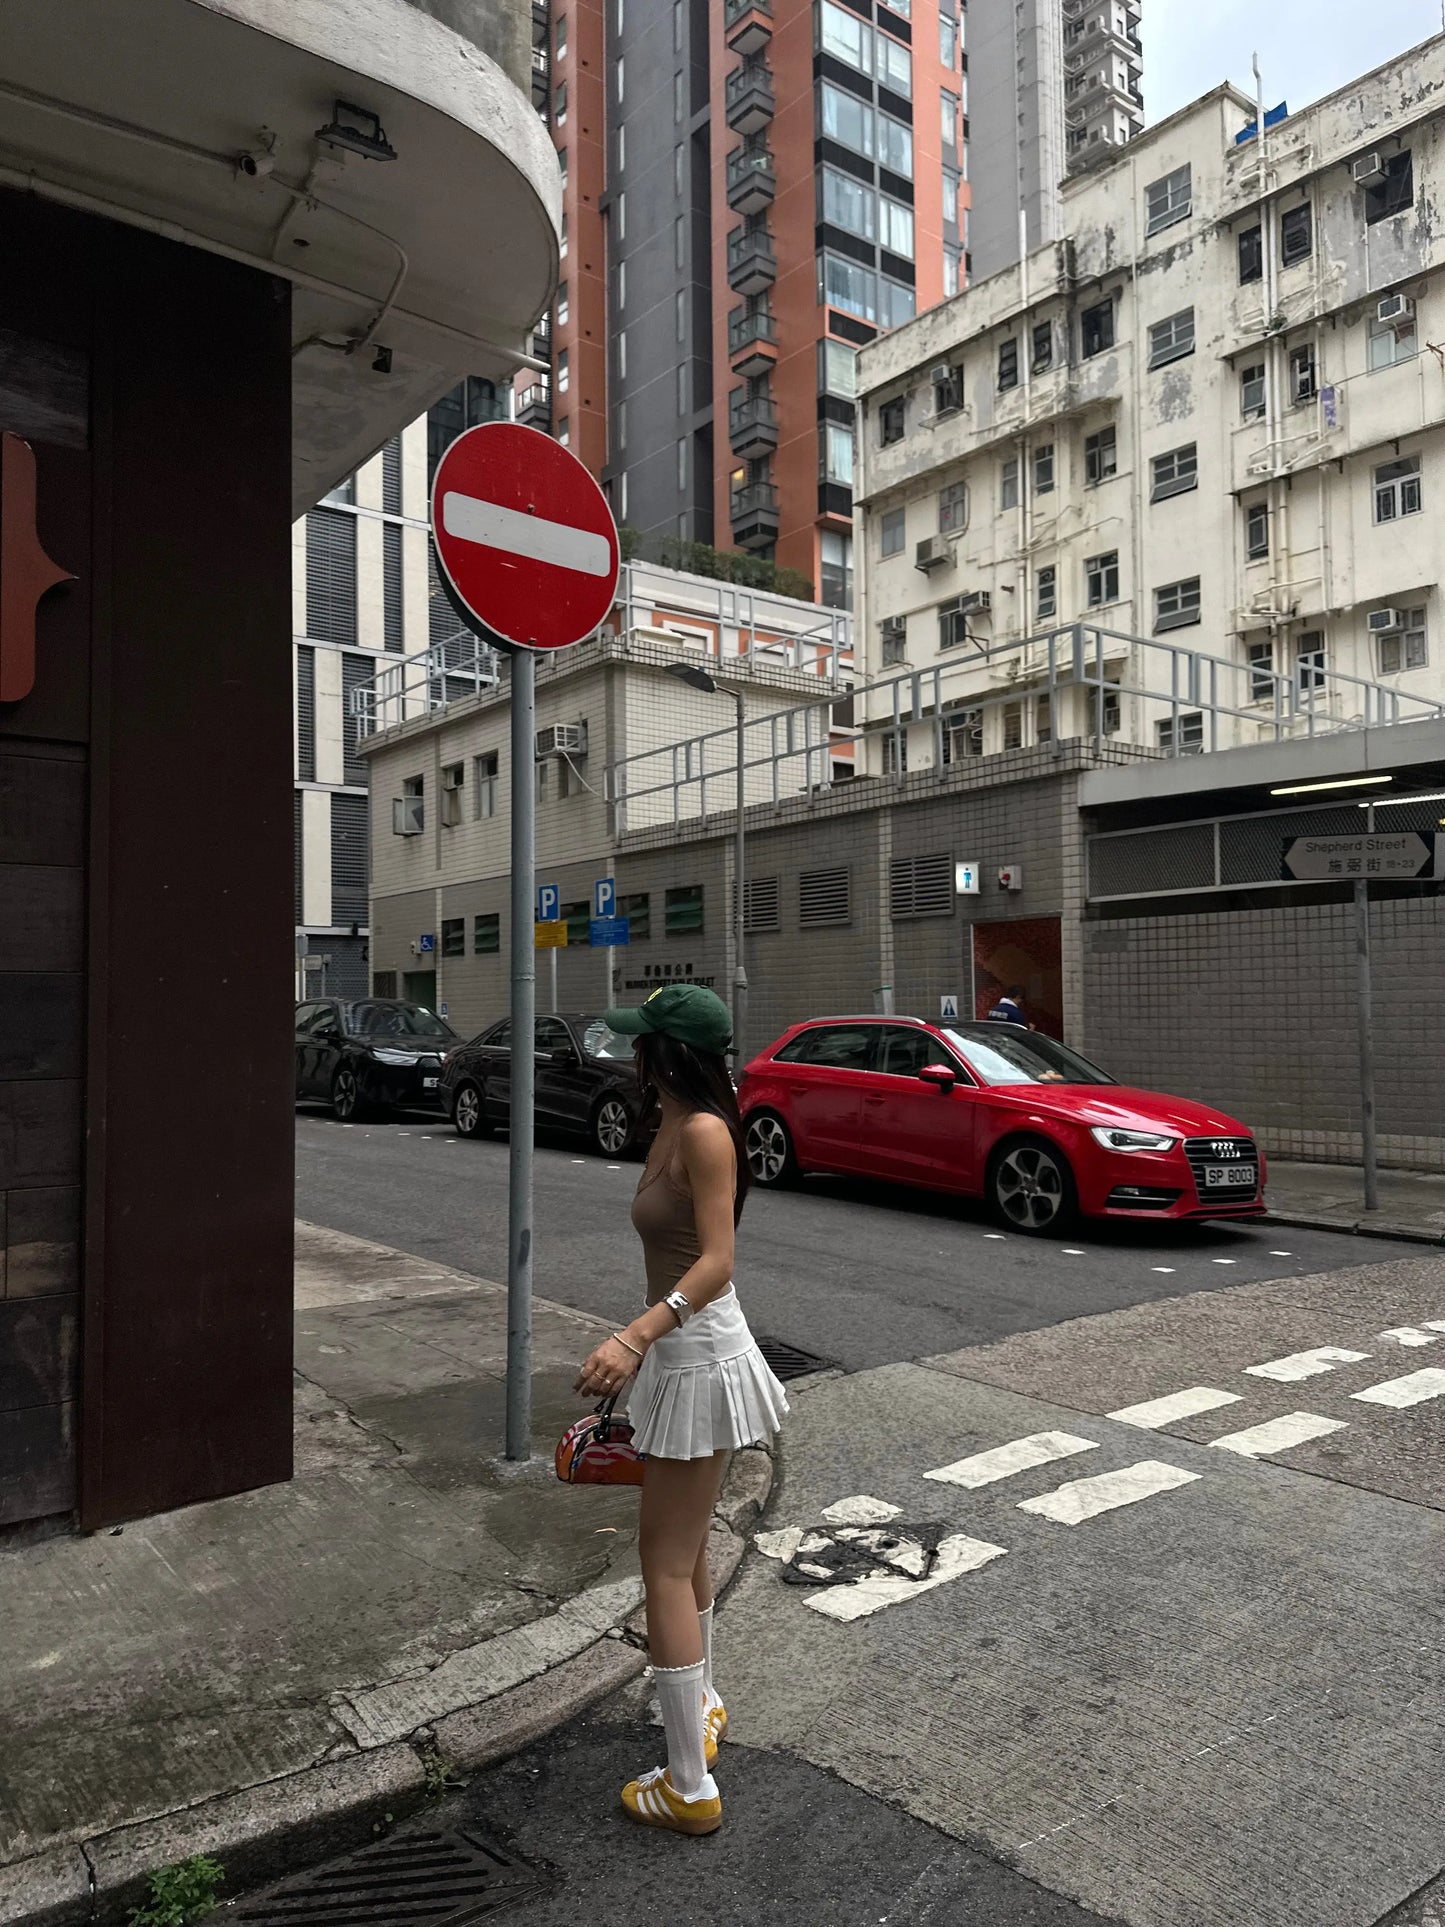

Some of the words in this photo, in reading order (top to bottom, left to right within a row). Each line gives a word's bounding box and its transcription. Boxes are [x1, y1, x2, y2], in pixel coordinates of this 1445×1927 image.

[1306, 840, 1362, 854] Shepherd
[1366, 838, 1406, 851] Street
[541, 888, 555, 917] P
[598, 883, 612, 914] P
[1209, 1169, 1223, 1184] SP
[1228, 1168, 1252, 1183] 8003
